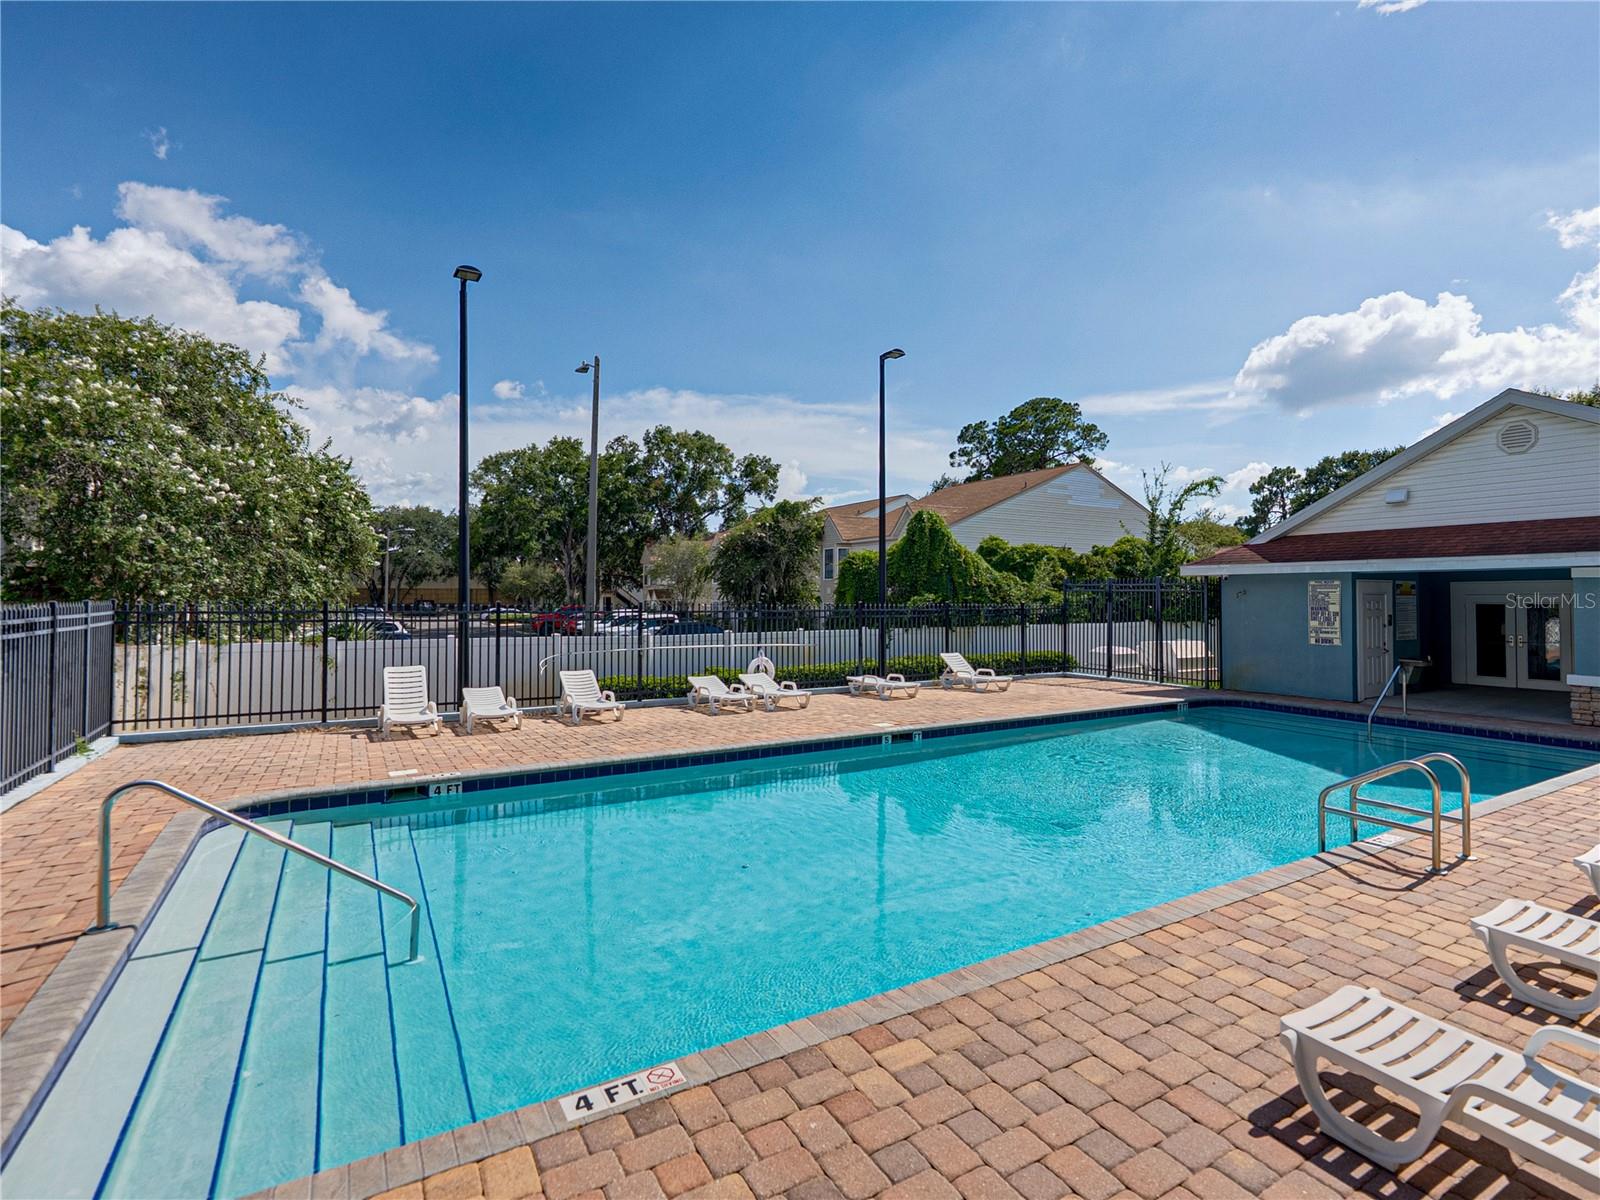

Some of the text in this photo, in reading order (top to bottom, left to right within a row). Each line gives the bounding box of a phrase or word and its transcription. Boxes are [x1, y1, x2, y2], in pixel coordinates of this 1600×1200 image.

[434, 784, 461, 795] 4 FT
[575, 1078, 643, 1111] 4 FT.
